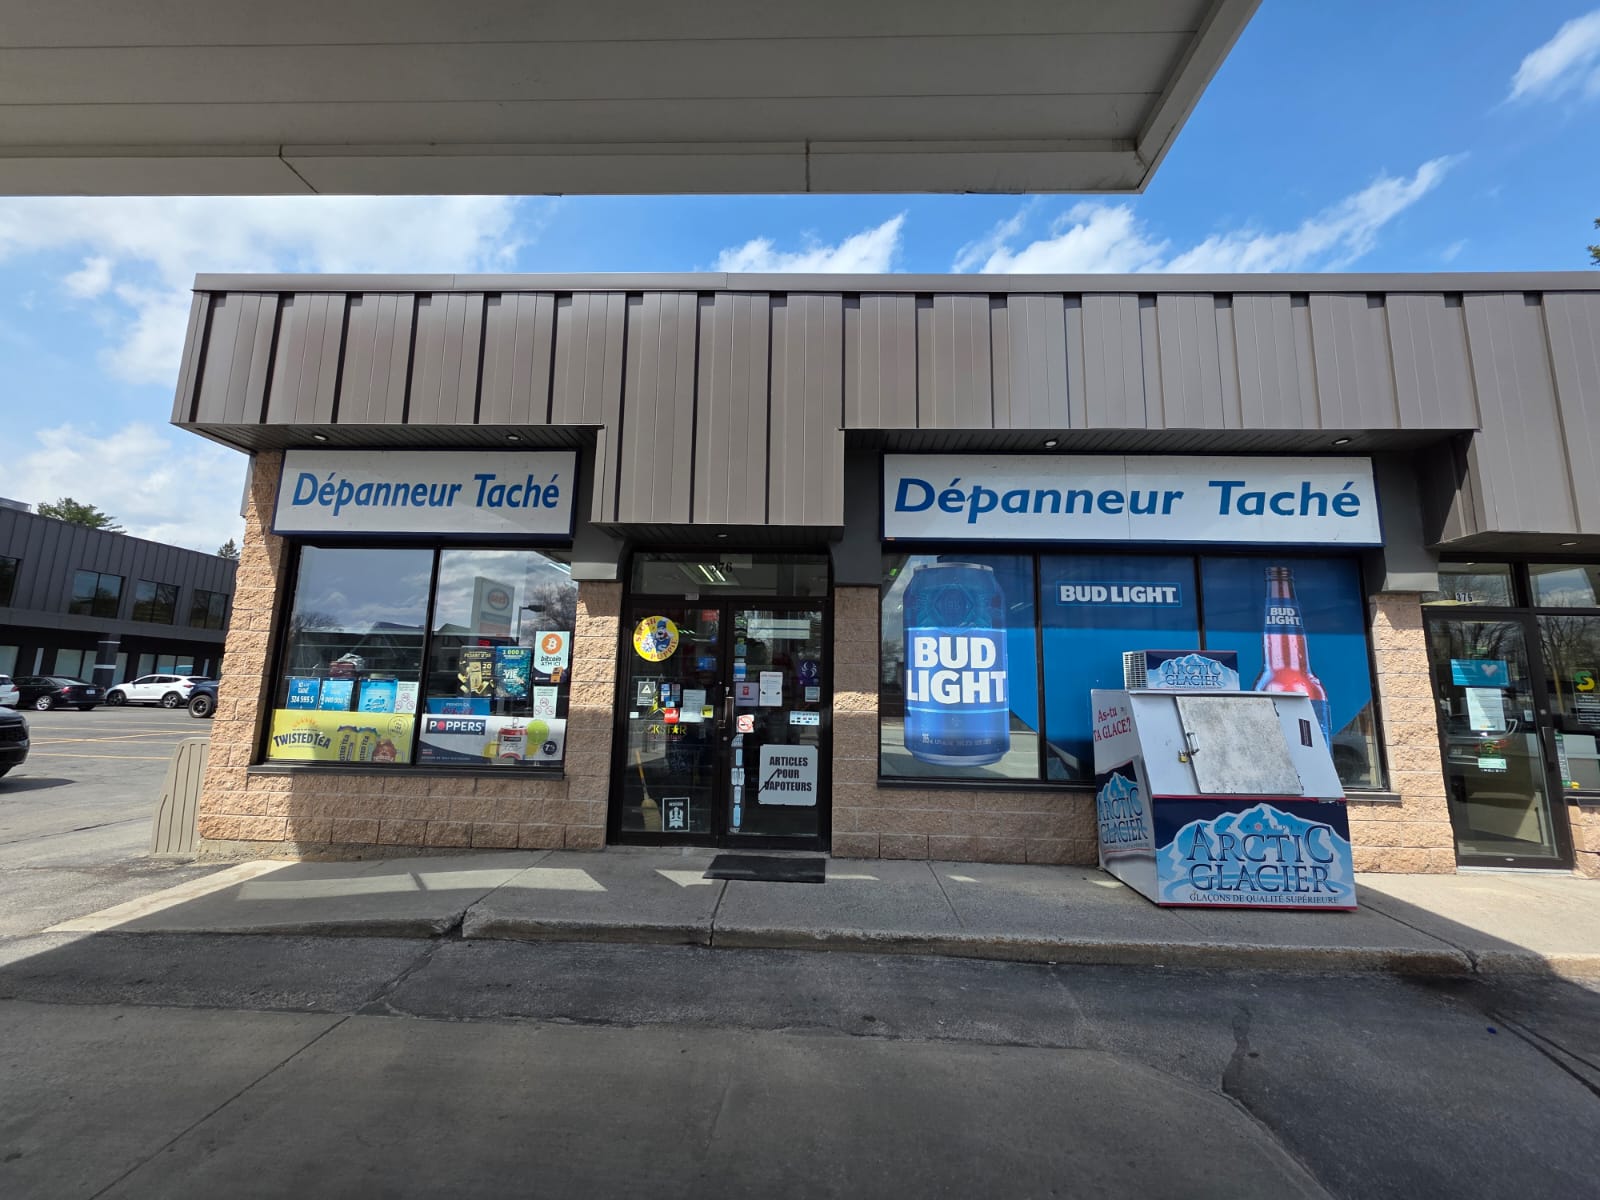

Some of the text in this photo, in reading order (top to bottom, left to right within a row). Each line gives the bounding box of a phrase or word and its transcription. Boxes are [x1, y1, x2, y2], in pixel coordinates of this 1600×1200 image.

[291, 472, 560, 516] Dépanneur Taché
[894, 477, 1361, 524] Dépanneur Taché
[1060, 585, 1177, 603] BUD LIGHT
[1456, 592, 1473, 602] 375
[1266, 615, 1301, 626] LIGHT
[1270, 607, 1296, 617] BUD
[914, 636, 996, 669] BUD
[1164, 660, 1221, 675] ARCTIC
[906, 669, 1007, 705] LIGHT
[1165, 674, 1222, 686] GLACIER
[1098, 706, 1118, 723] As-tu
[429, 720, 482, 732] POPPERS
[1102, 716, 1132, 739] GLACE?
[273, 732, 332, 749] TWISTED TEA
[769, 756, 808, 767] ARTICLES
[776, 768, 800, 779] POUR
[764, 781, 812, 792] VAPOTEURS
[1097, 787, 1143, 822] ARCTIC
[1101, 817, 1148, 844] GLACIER
[1186, 823, 1334, 864] ARCTIC
[1188, 863, 1339, 893] GLACIER
[1189, 893, 1339, 904] GLAÇONS DE QUALITÉ SUPÉRIEURE
